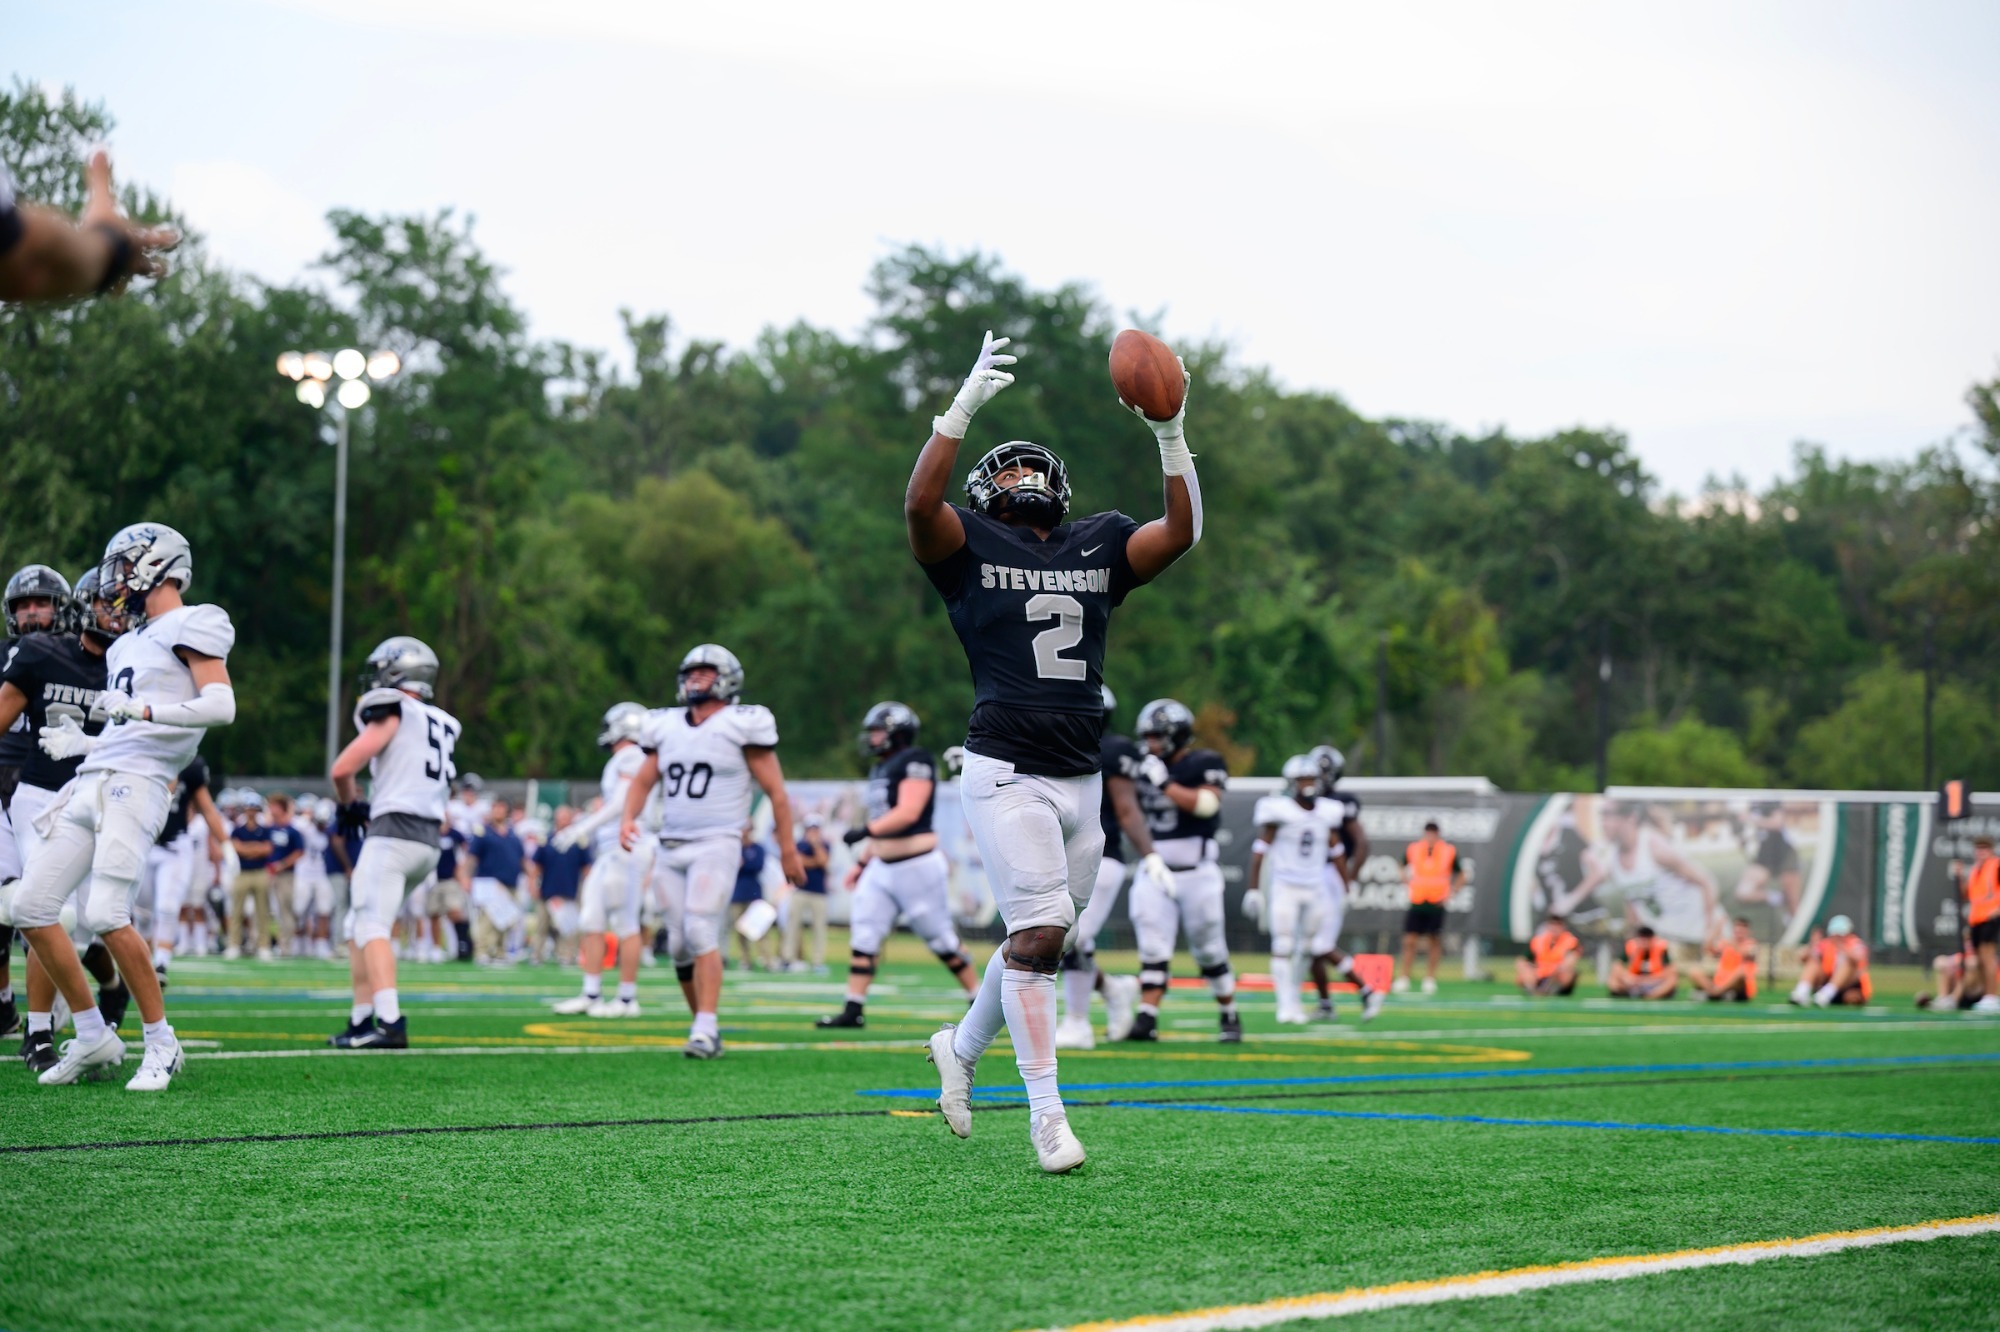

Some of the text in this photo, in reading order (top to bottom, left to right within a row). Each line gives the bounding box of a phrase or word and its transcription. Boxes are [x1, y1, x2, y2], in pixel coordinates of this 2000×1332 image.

[980, 563, 1111, 593] STEVENSON
[1025, 593, 1087, 681] 2
[668, 762, 713, 799] 90
[1945, 779, 1963, 818] 1
